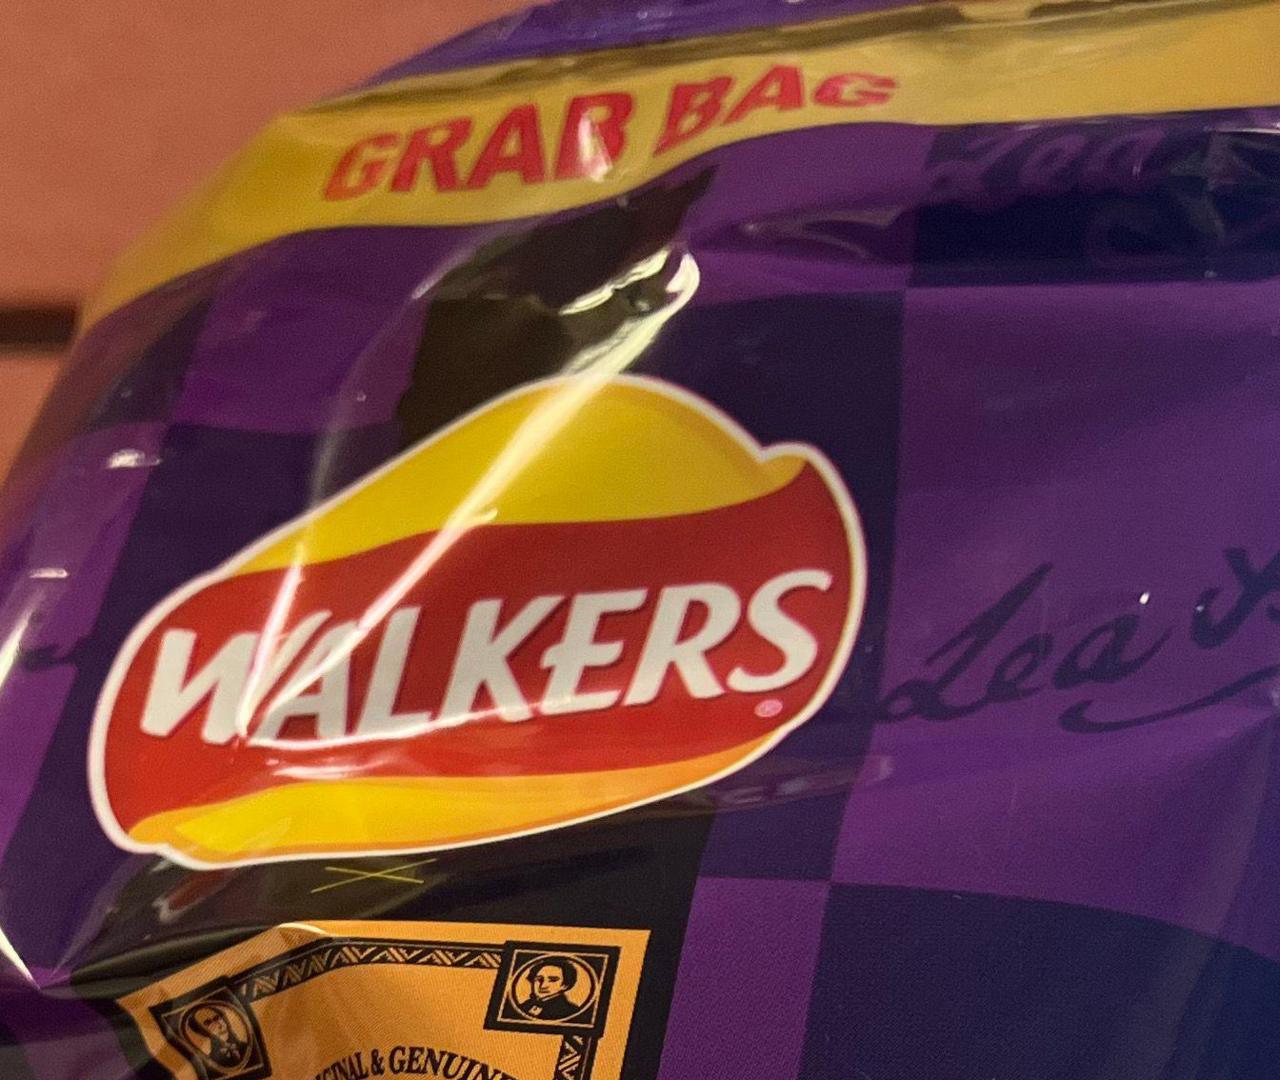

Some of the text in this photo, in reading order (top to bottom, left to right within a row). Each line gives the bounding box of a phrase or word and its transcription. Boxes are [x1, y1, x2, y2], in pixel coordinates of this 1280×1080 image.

[322, 64, 898, 201] GRAB BAG
[139, 568, 833, 747] WALKERS
[371, 1049, 385, 1076] &
